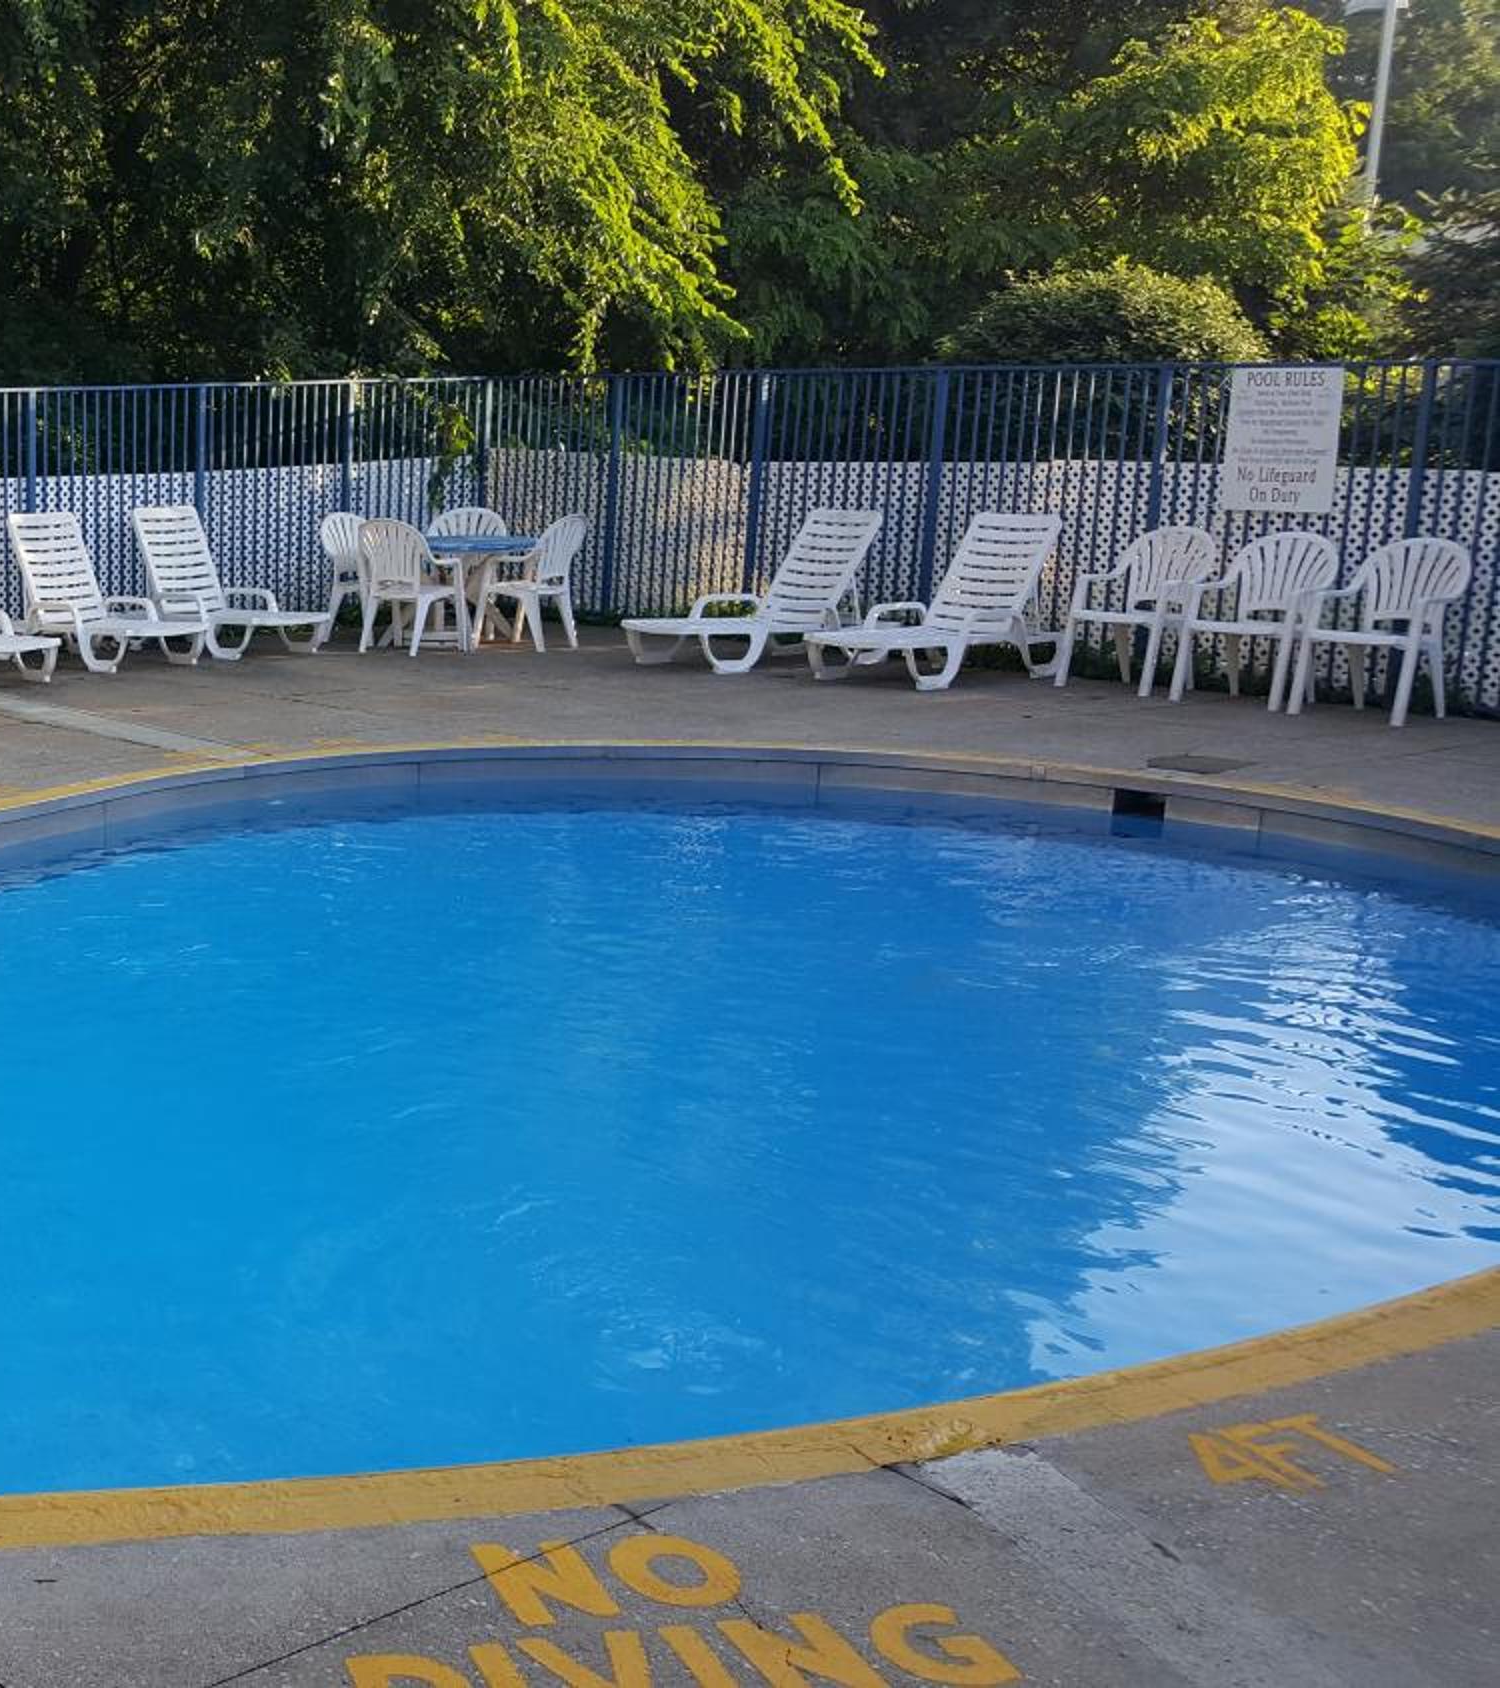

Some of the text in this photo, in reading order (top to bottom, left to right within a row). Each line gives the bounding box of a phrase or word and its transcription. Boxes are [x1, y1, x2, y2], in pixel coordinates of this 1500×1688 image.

[1247, 371, 1325, 387] POOL RULES
[1237, 466, 1317, 487] No Lifeguard
[1250, 487, 1300, 506] On Duty
[1187, 1414, 1395, 1491] 4FT
[470, 1535, 742, 1628] NO
